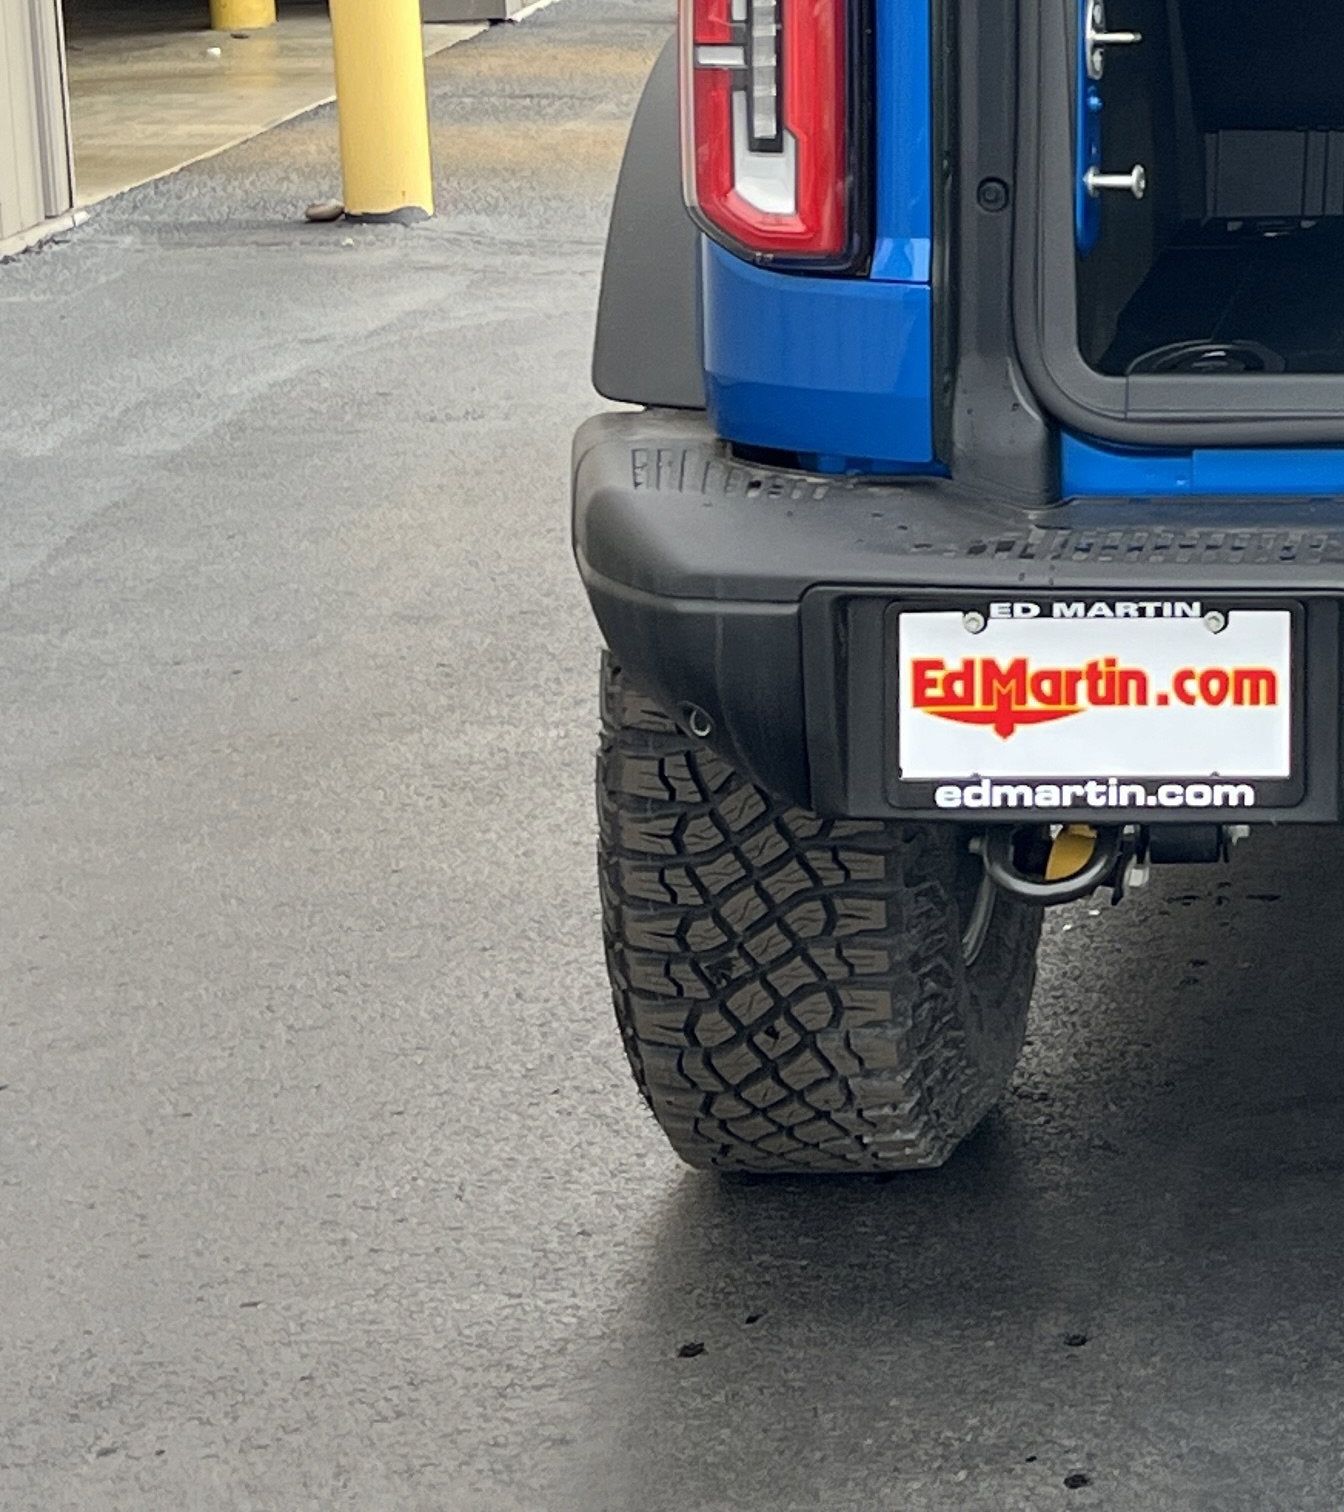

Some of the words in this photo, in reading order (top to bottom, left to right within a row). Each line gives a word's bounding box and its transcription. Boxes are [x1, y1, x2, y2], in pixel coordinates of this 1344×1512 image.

[989, 602, 1040, 618] ED
[1052, 601, 1202, 618] MARTIN
[910, 656, 1278, 714] EdMartin.com
[935, 778, 1255, 808] edmartin.com
